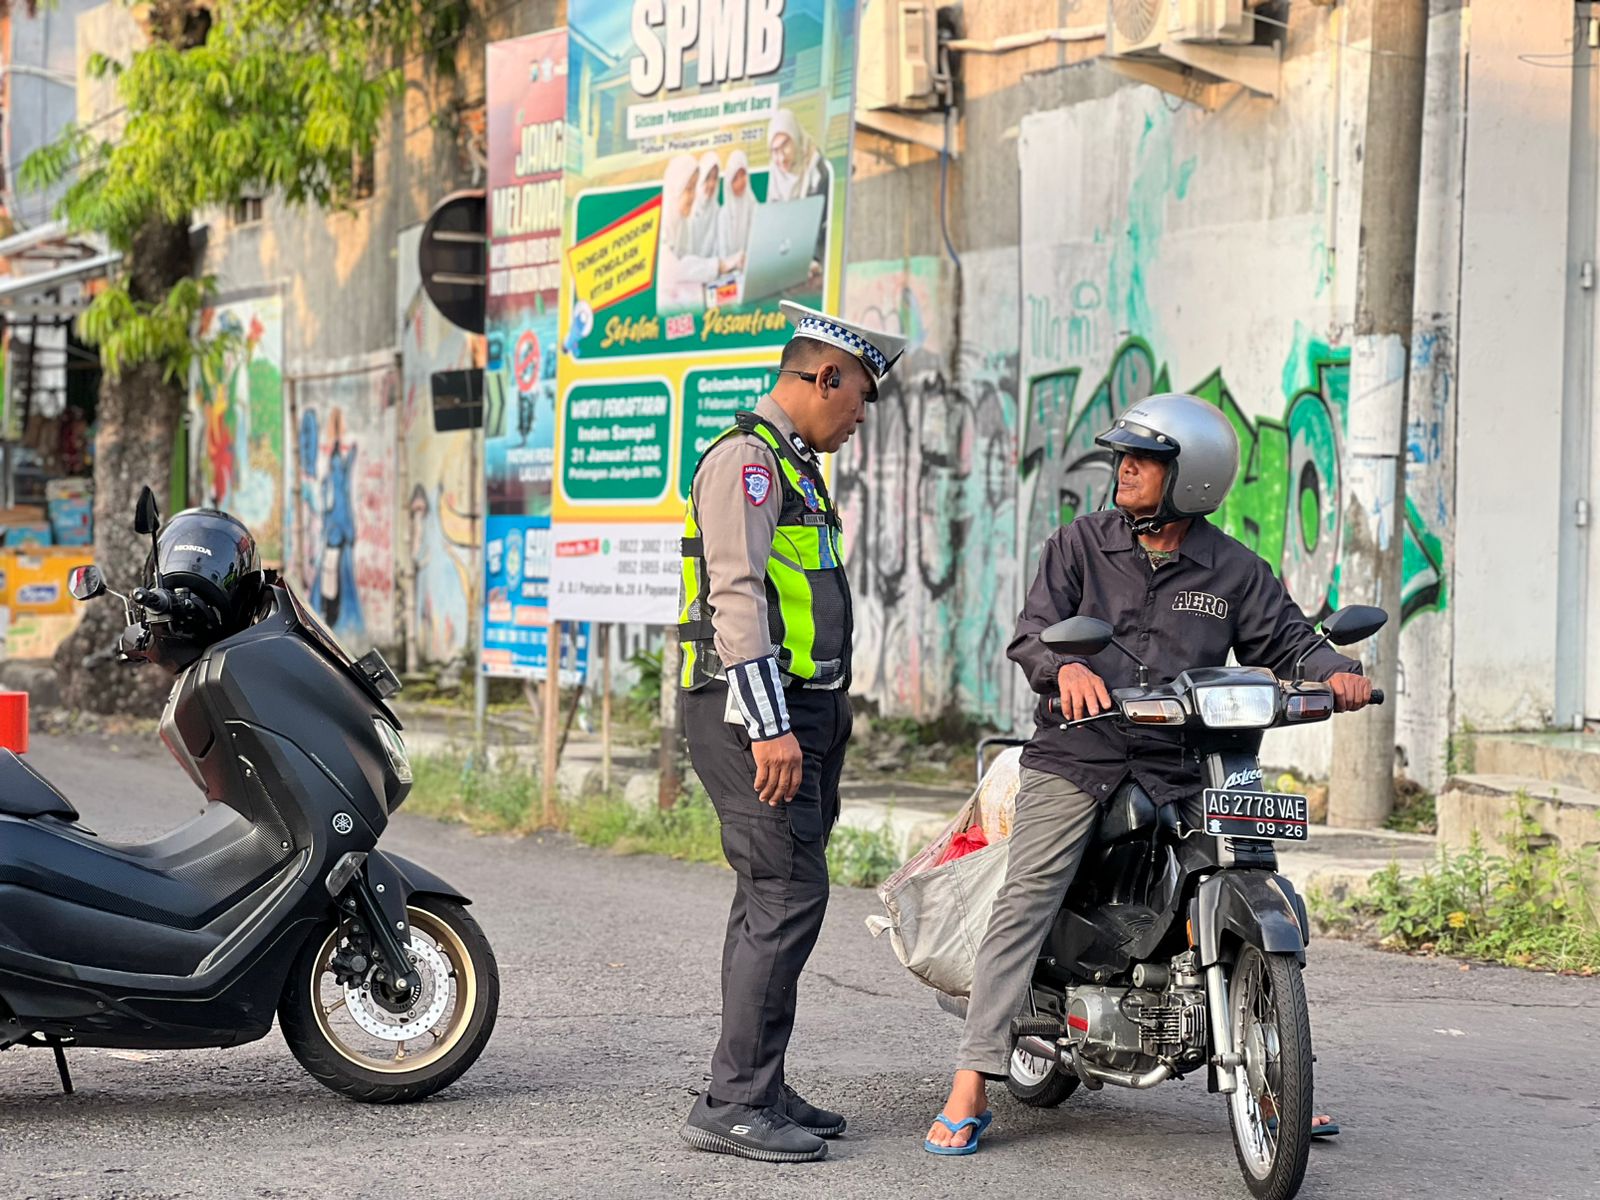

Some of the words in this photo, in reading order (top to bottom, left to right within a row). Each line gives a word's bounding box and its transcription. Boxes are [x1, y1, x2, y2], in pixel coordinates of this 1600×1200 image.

[630, 0, 785, 97] SPMB
[635, 109, 664, 129] Sistem
[667, 105, 719, 124] Penerimaan
[751, 96, 771, 111] Baru
[640, 142, 664, 154] Tahun
[668, 137, 709, 151] Pelajaran
[601, 314, 659, 349] Sekolah
[701, 305, 787, 342] Pesantren
[698, 375, 762, 393] Gelombang
[578, 425, 610, 442] Inden
[611, 422, 656, 444] Sampai
[571, 447, 585, 463] 31
[587, 446, 631, 463] Januari
[174, 544, 212, 557] HONDA
[1172, 591, 1228, 619] AERO
[1208, 793, 1229, 814] AG
[1233, 795, 1274, 818] 2778
[1277, 798, 1304, 820] VAE
